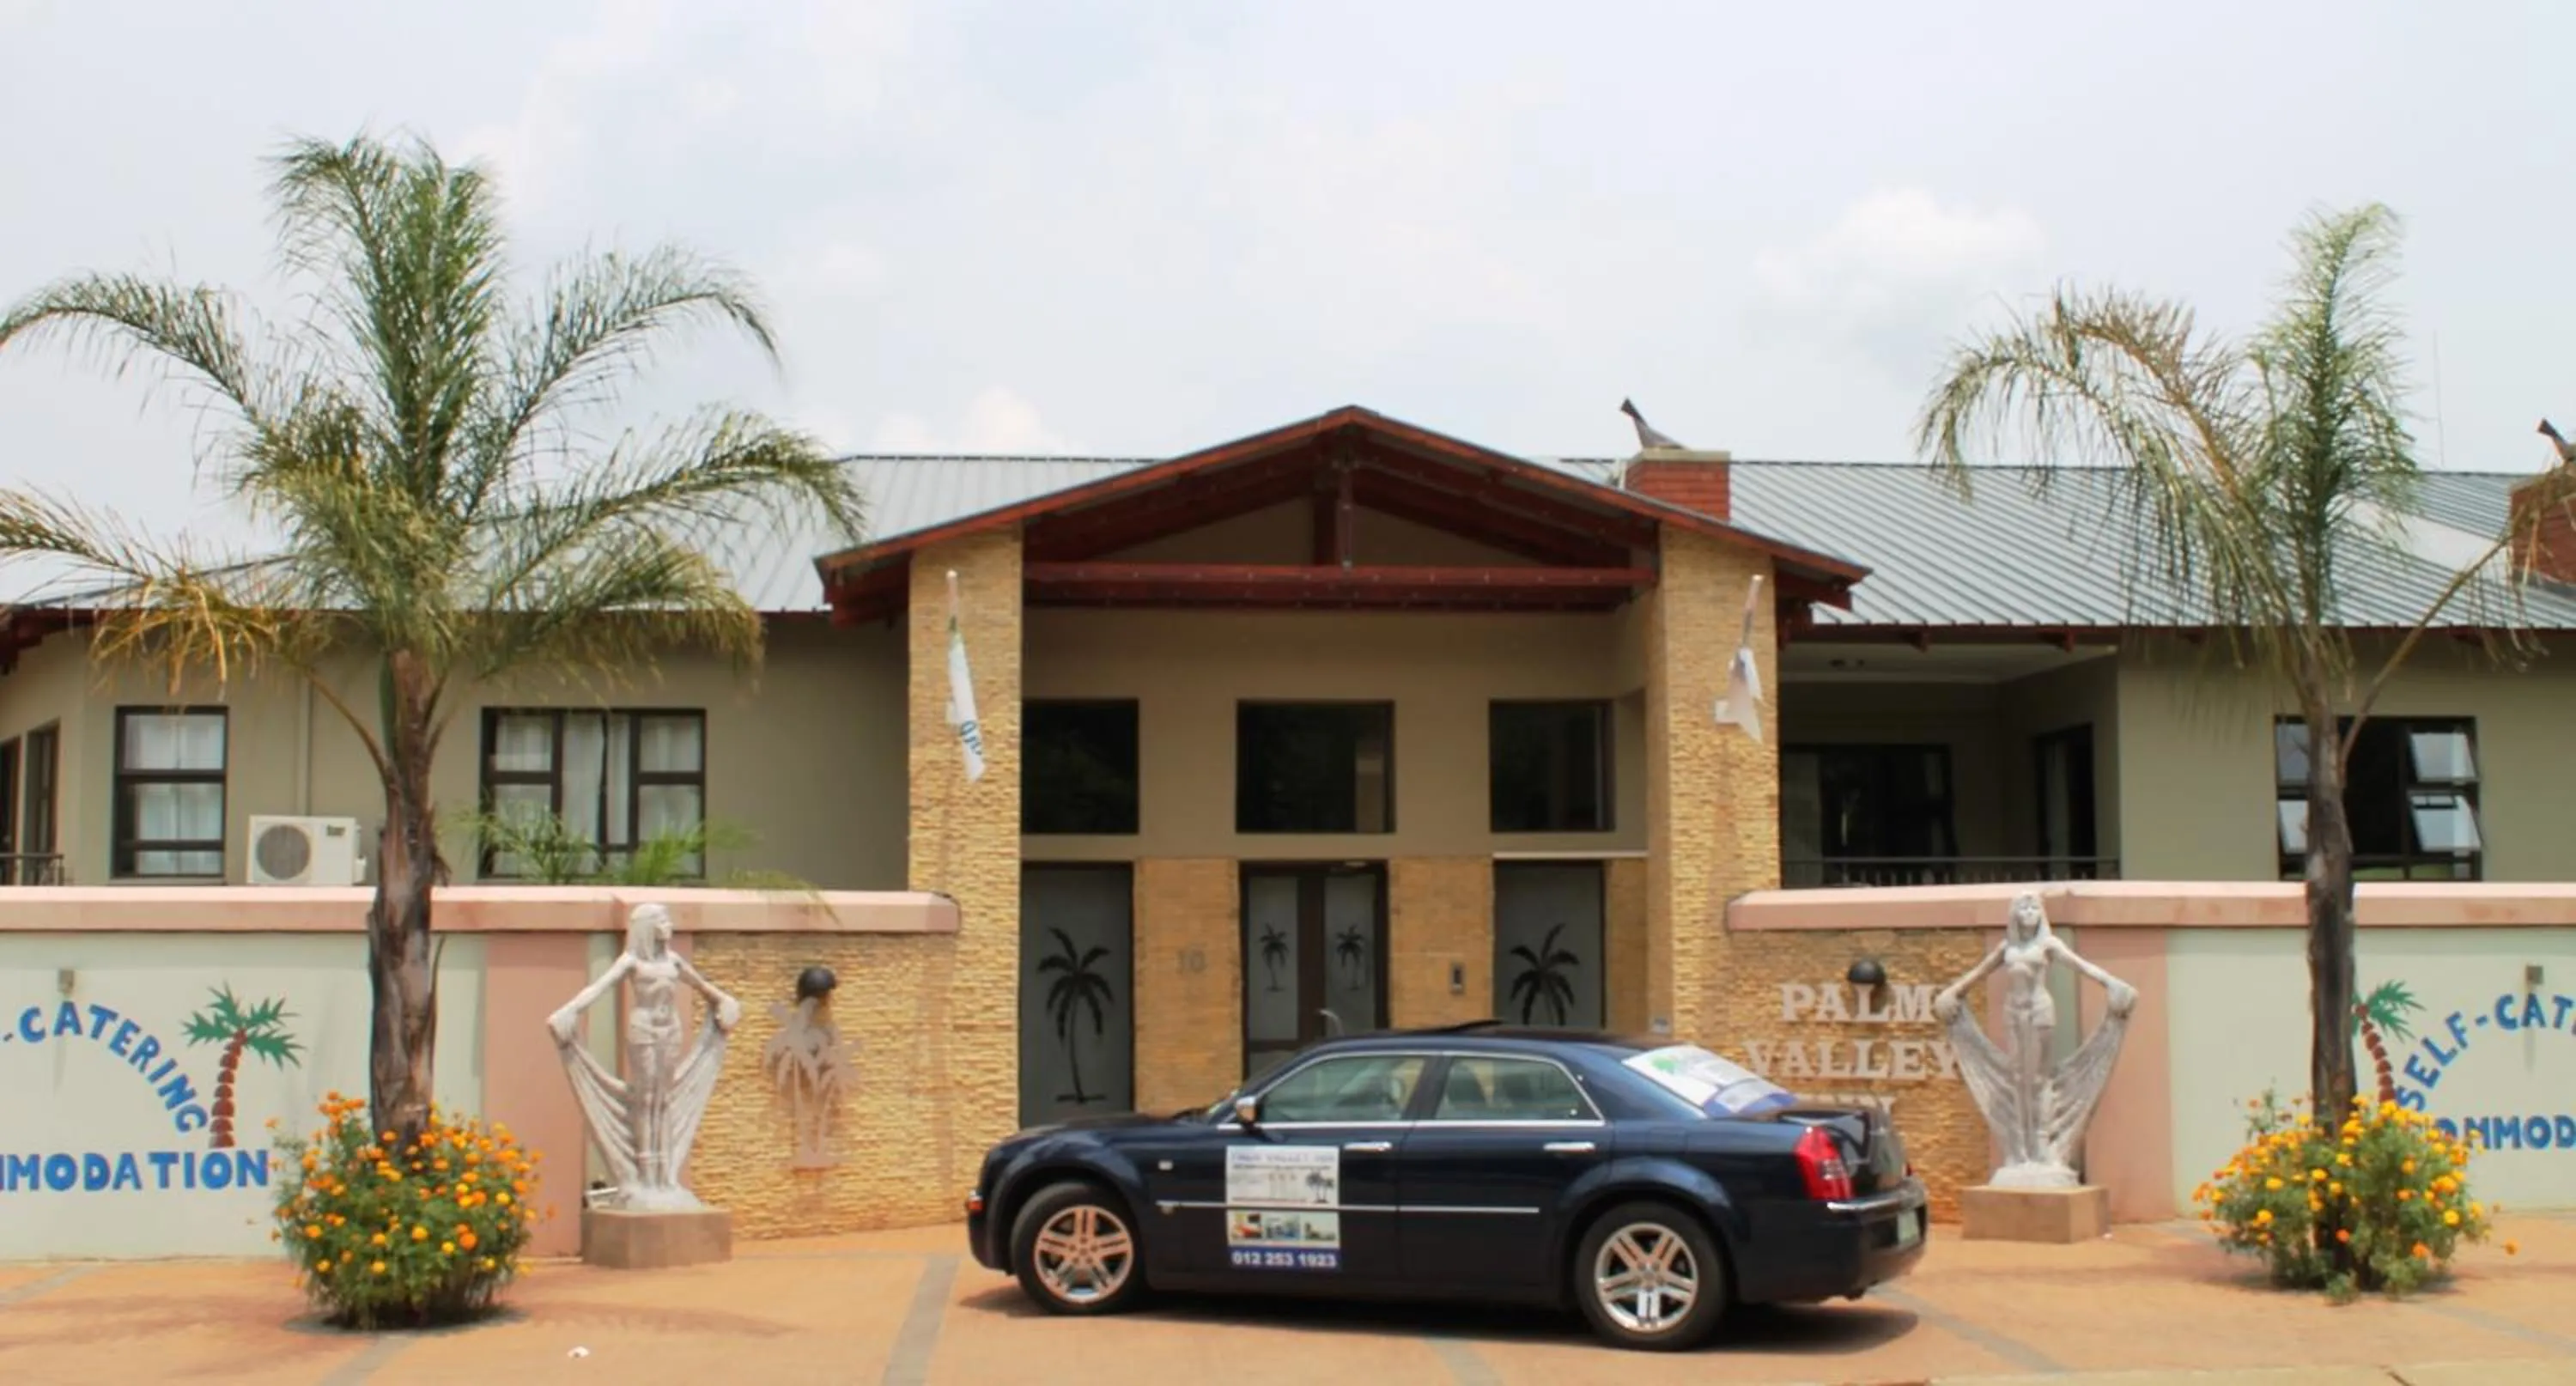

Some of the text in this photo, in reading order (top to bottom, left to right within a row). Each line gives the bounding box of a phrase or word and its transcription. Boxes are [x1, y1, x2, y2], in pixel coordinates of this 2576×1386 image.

[1778, 982, 1937, 1023] PALM
[1742, 1039, 1961, 1080] VALLEY
[2396, 993, 2576, 1111] SELF-CAT
[0, 1149, 269, 1192] MODATION
[1231, 1250, 1261, 1265] 012
